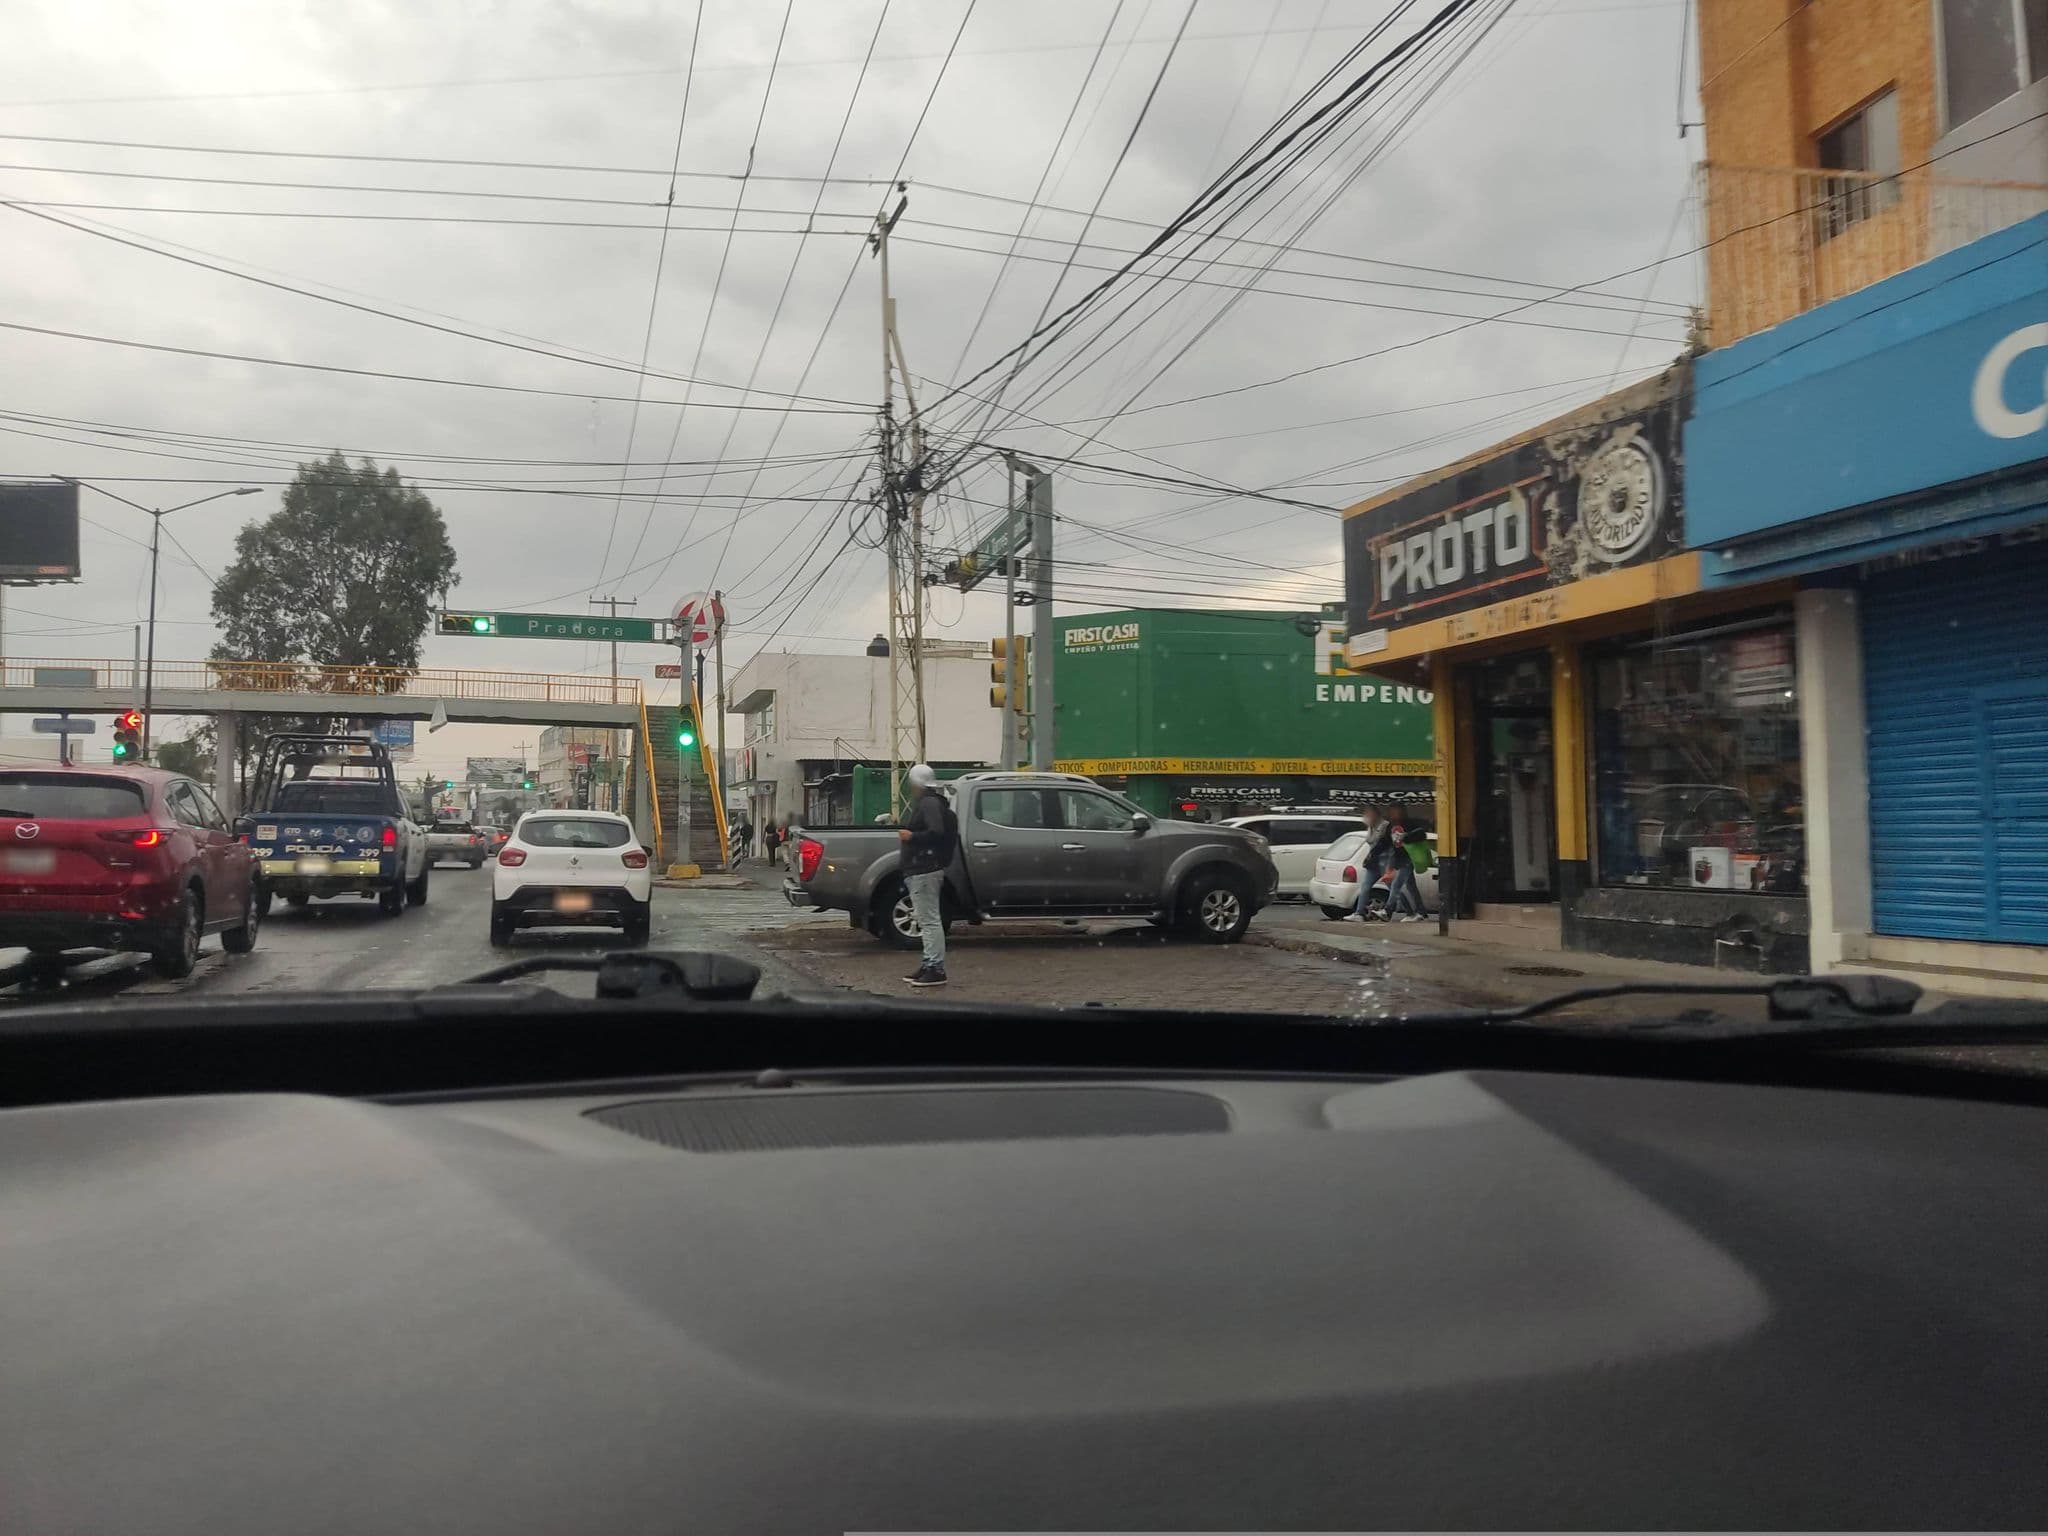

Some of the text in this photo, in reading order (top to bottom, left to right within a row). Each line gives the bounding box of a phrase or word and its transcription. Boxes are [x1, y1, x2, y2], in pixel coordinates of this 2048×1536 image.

[1380, 500, 1528, 602] PROTO
[528, 620, 624, 637] Pradera
[1097, 760, 1169, 772] COMPUTADORAS
[1183, 761, 1257, 772] HERRAMIENTAS
[1321, 763, 1371, 773] CELULARES
[358, 848, 380, 857] 299
